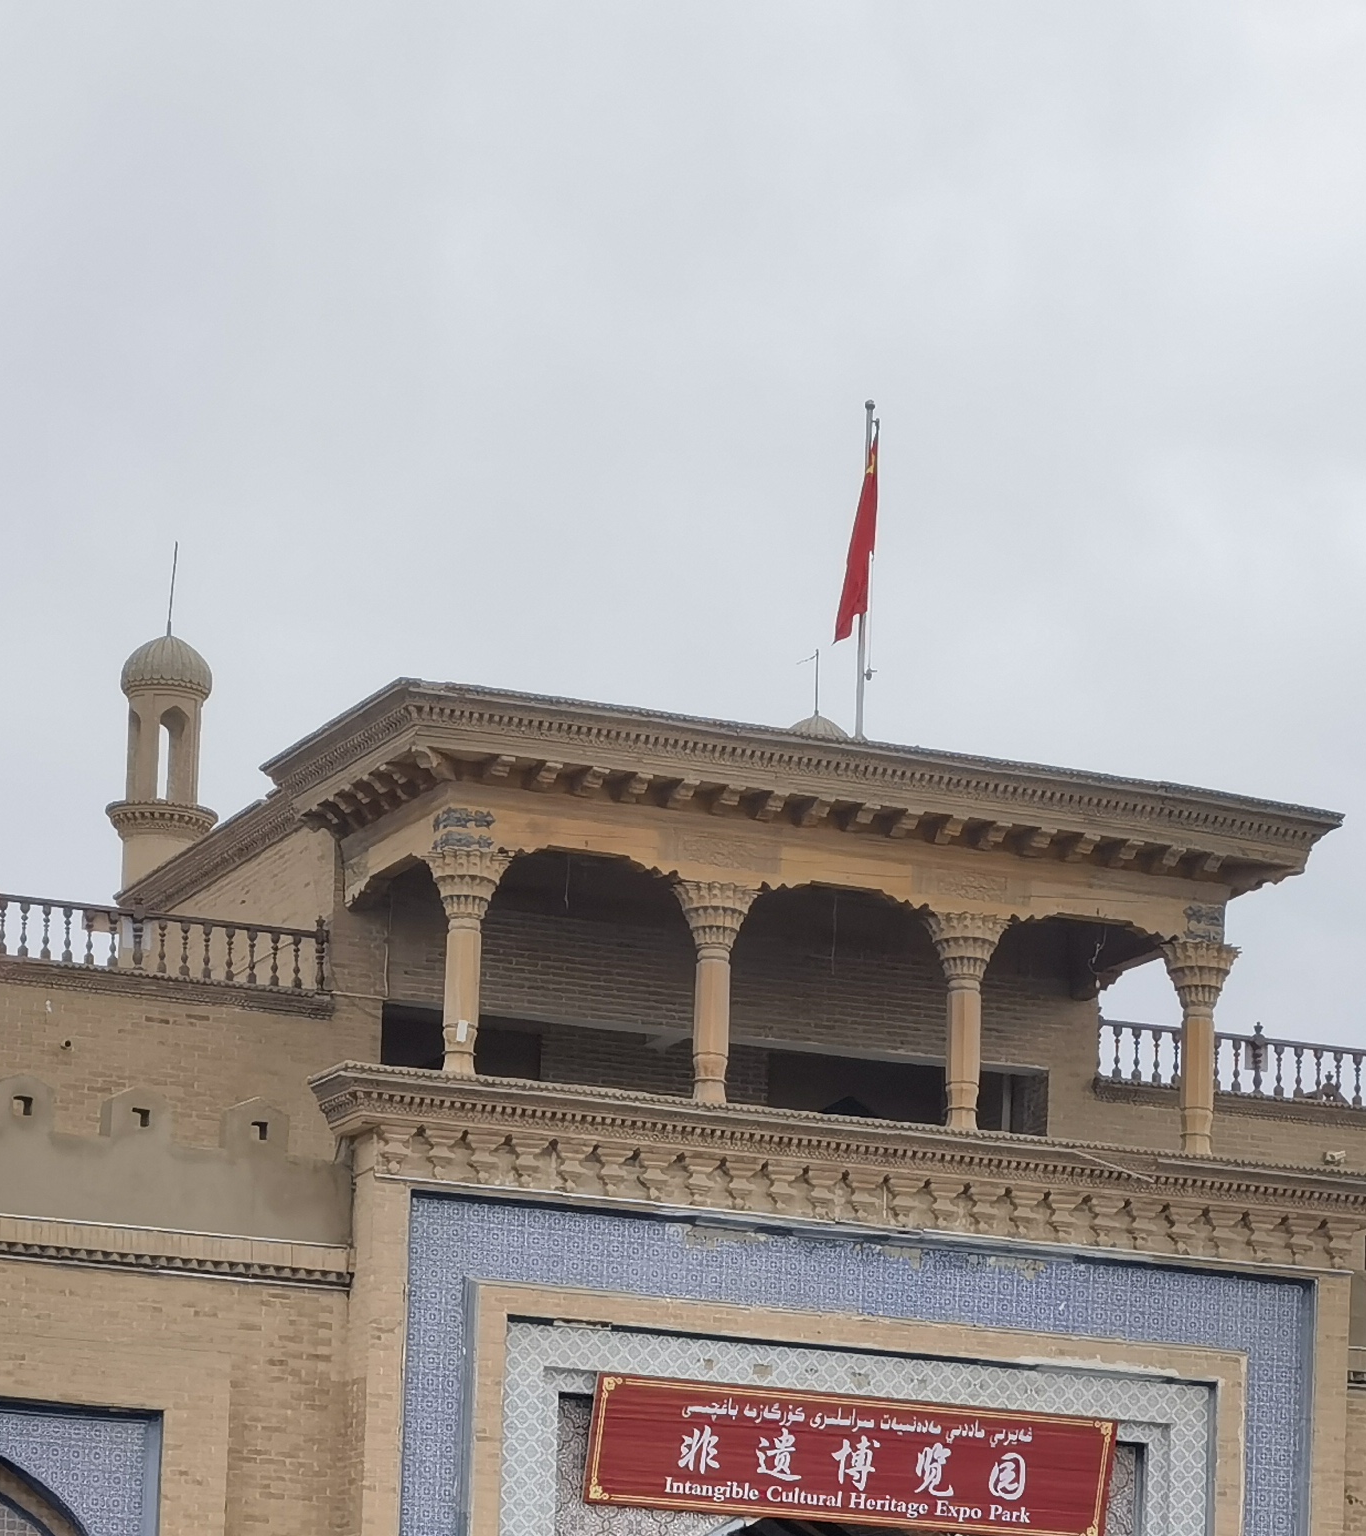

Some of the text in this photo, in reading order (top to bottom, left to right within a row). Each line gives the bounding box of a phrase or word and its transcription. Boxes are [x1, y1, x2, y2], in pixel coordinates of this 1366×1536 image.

[677, 1424, 1027, 1502] 非遗博览园
[664, 1476, 1031, 1524] Intangible Cultural Heritage Expo Park
